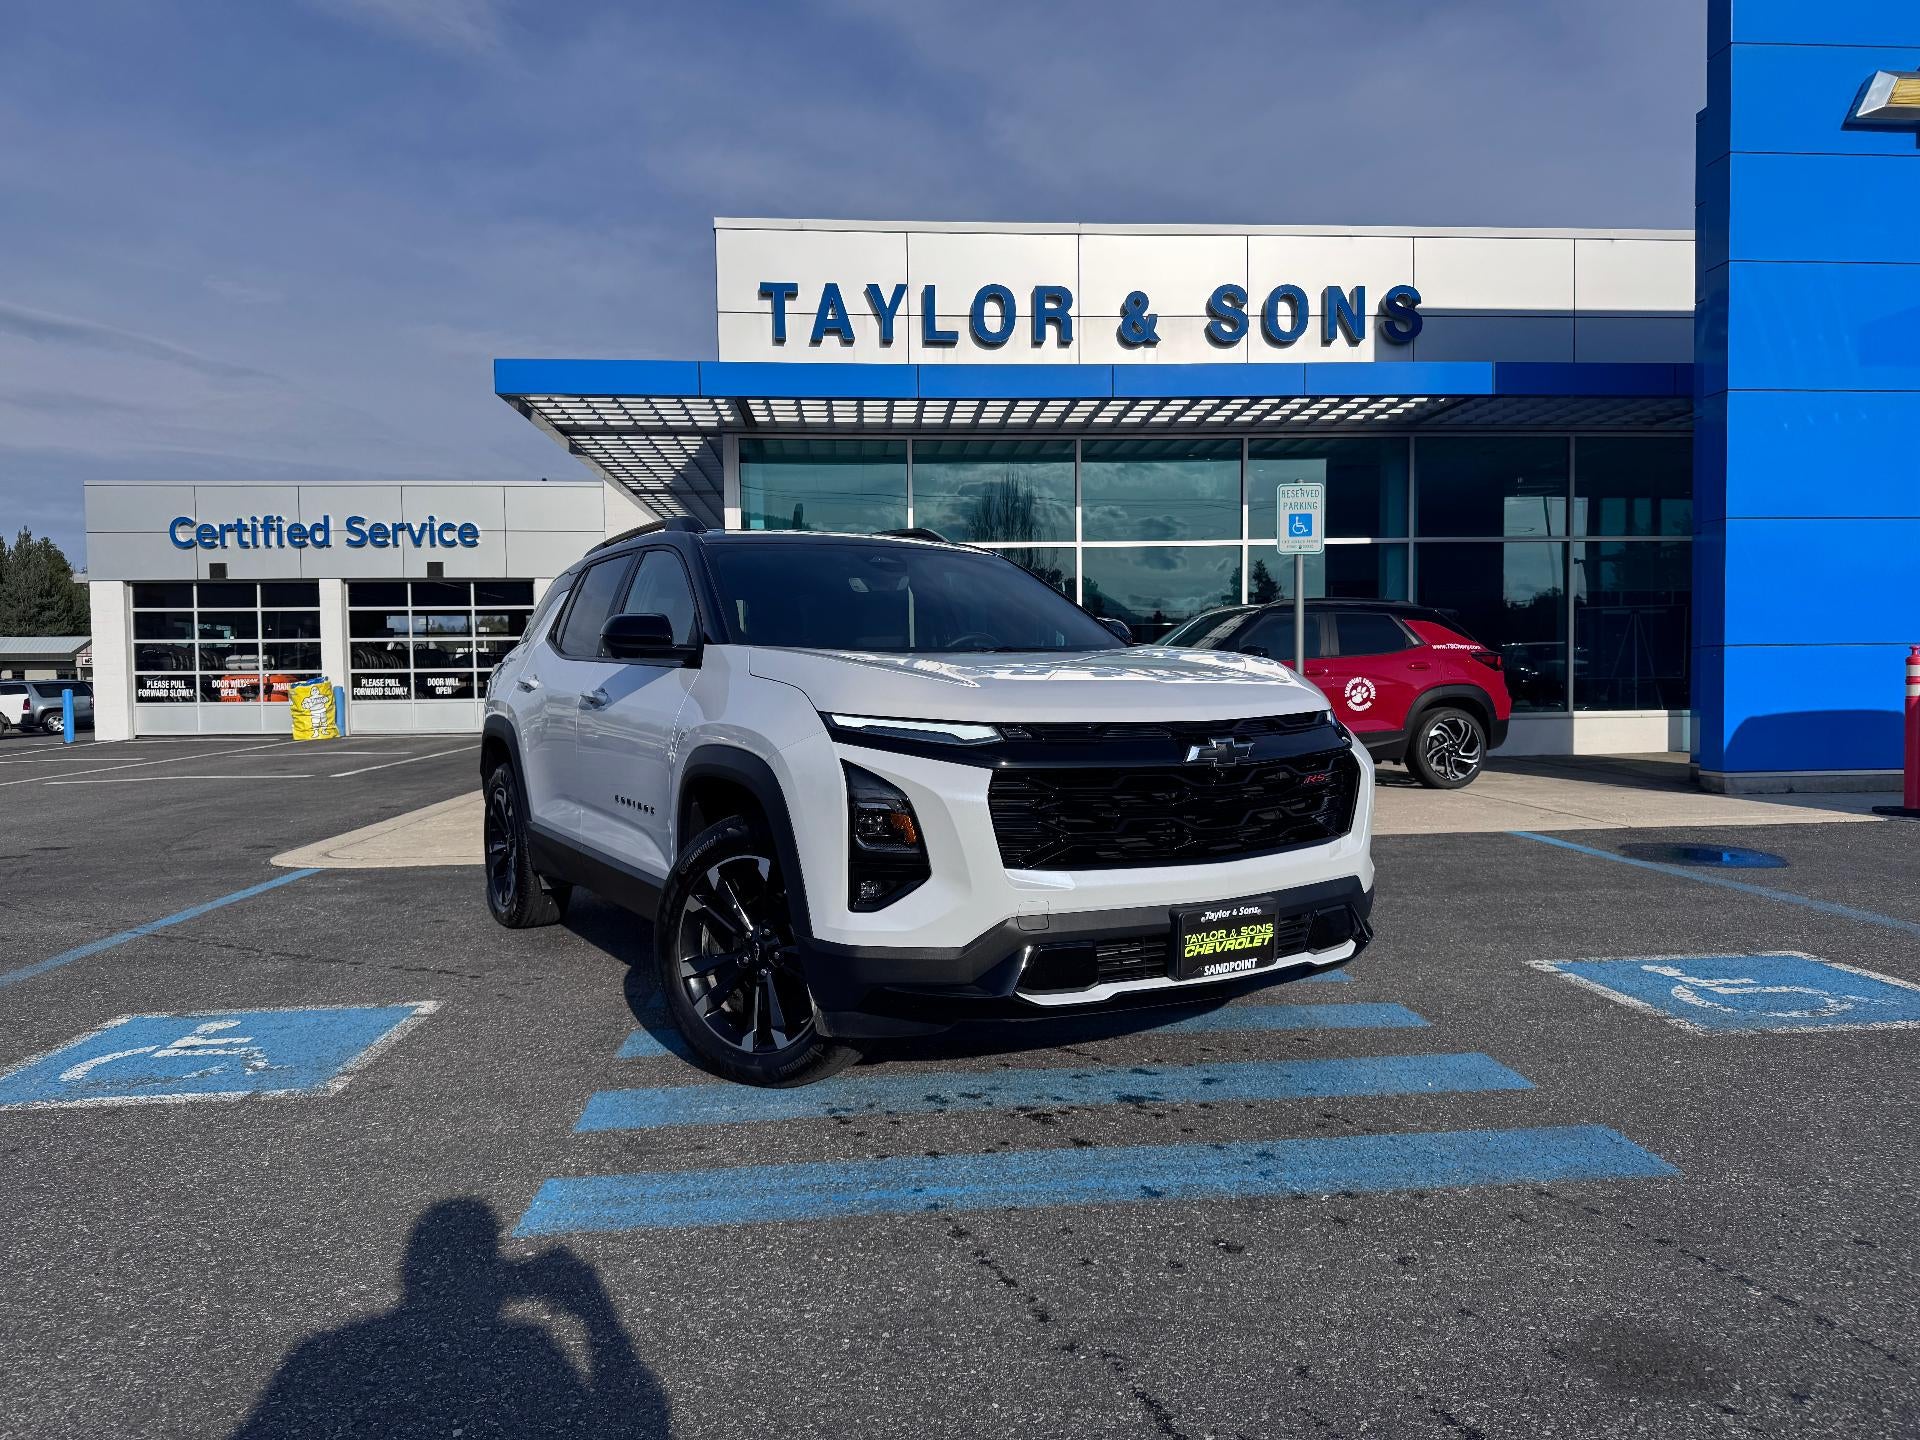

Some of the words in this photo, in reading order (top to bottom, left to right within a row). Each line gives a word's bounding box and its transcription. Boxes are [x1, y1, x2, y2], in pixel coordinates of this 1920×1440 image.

[758, 281, 1074, 349] TAYLOR
[1116, 290, 1161, 350] &
[1204, 284, 1423, 349] SONS
[1281, 489, 1320, 499] RESERVED
[1283, 501, 1318, 510] PARKING
[169, 515, 332, 549] Certified
[345, 515, 480, 549] Service
[146, 680, 170, 689] PLEASE
[171, 680, 186, 689] PULL
[212, 680, 229, 688] DOOR
[361, 679, 384, 687] PLEASE
[385, 678, 400, 686] PULL
[427, 678, 444, 686] DOOR
[445, 678, 460, 686] WILL
[138, 689, 169, 697] FORWARD
[170, 689, 194, 697] SLOWLY
[221, 688, 237, 696] OPEN
[353, 687, 383, 695] FORWARD
[384, 687, 408, 695] SLOWLY
[435, 686, 452, 694] OPEN
[1205, 910, 1231, 921] Taylor
[1239, 906, 1258, 915] Sons
[1185, 929, 1227, 945] TAYLOR
[1229, 929, 1237, 939] &
[1240, 923, 1273, 936] SONS
[1184, 933, 1274, 958] CHEVROLET
[1203, 958, 1258, 976] SANDPOINT
